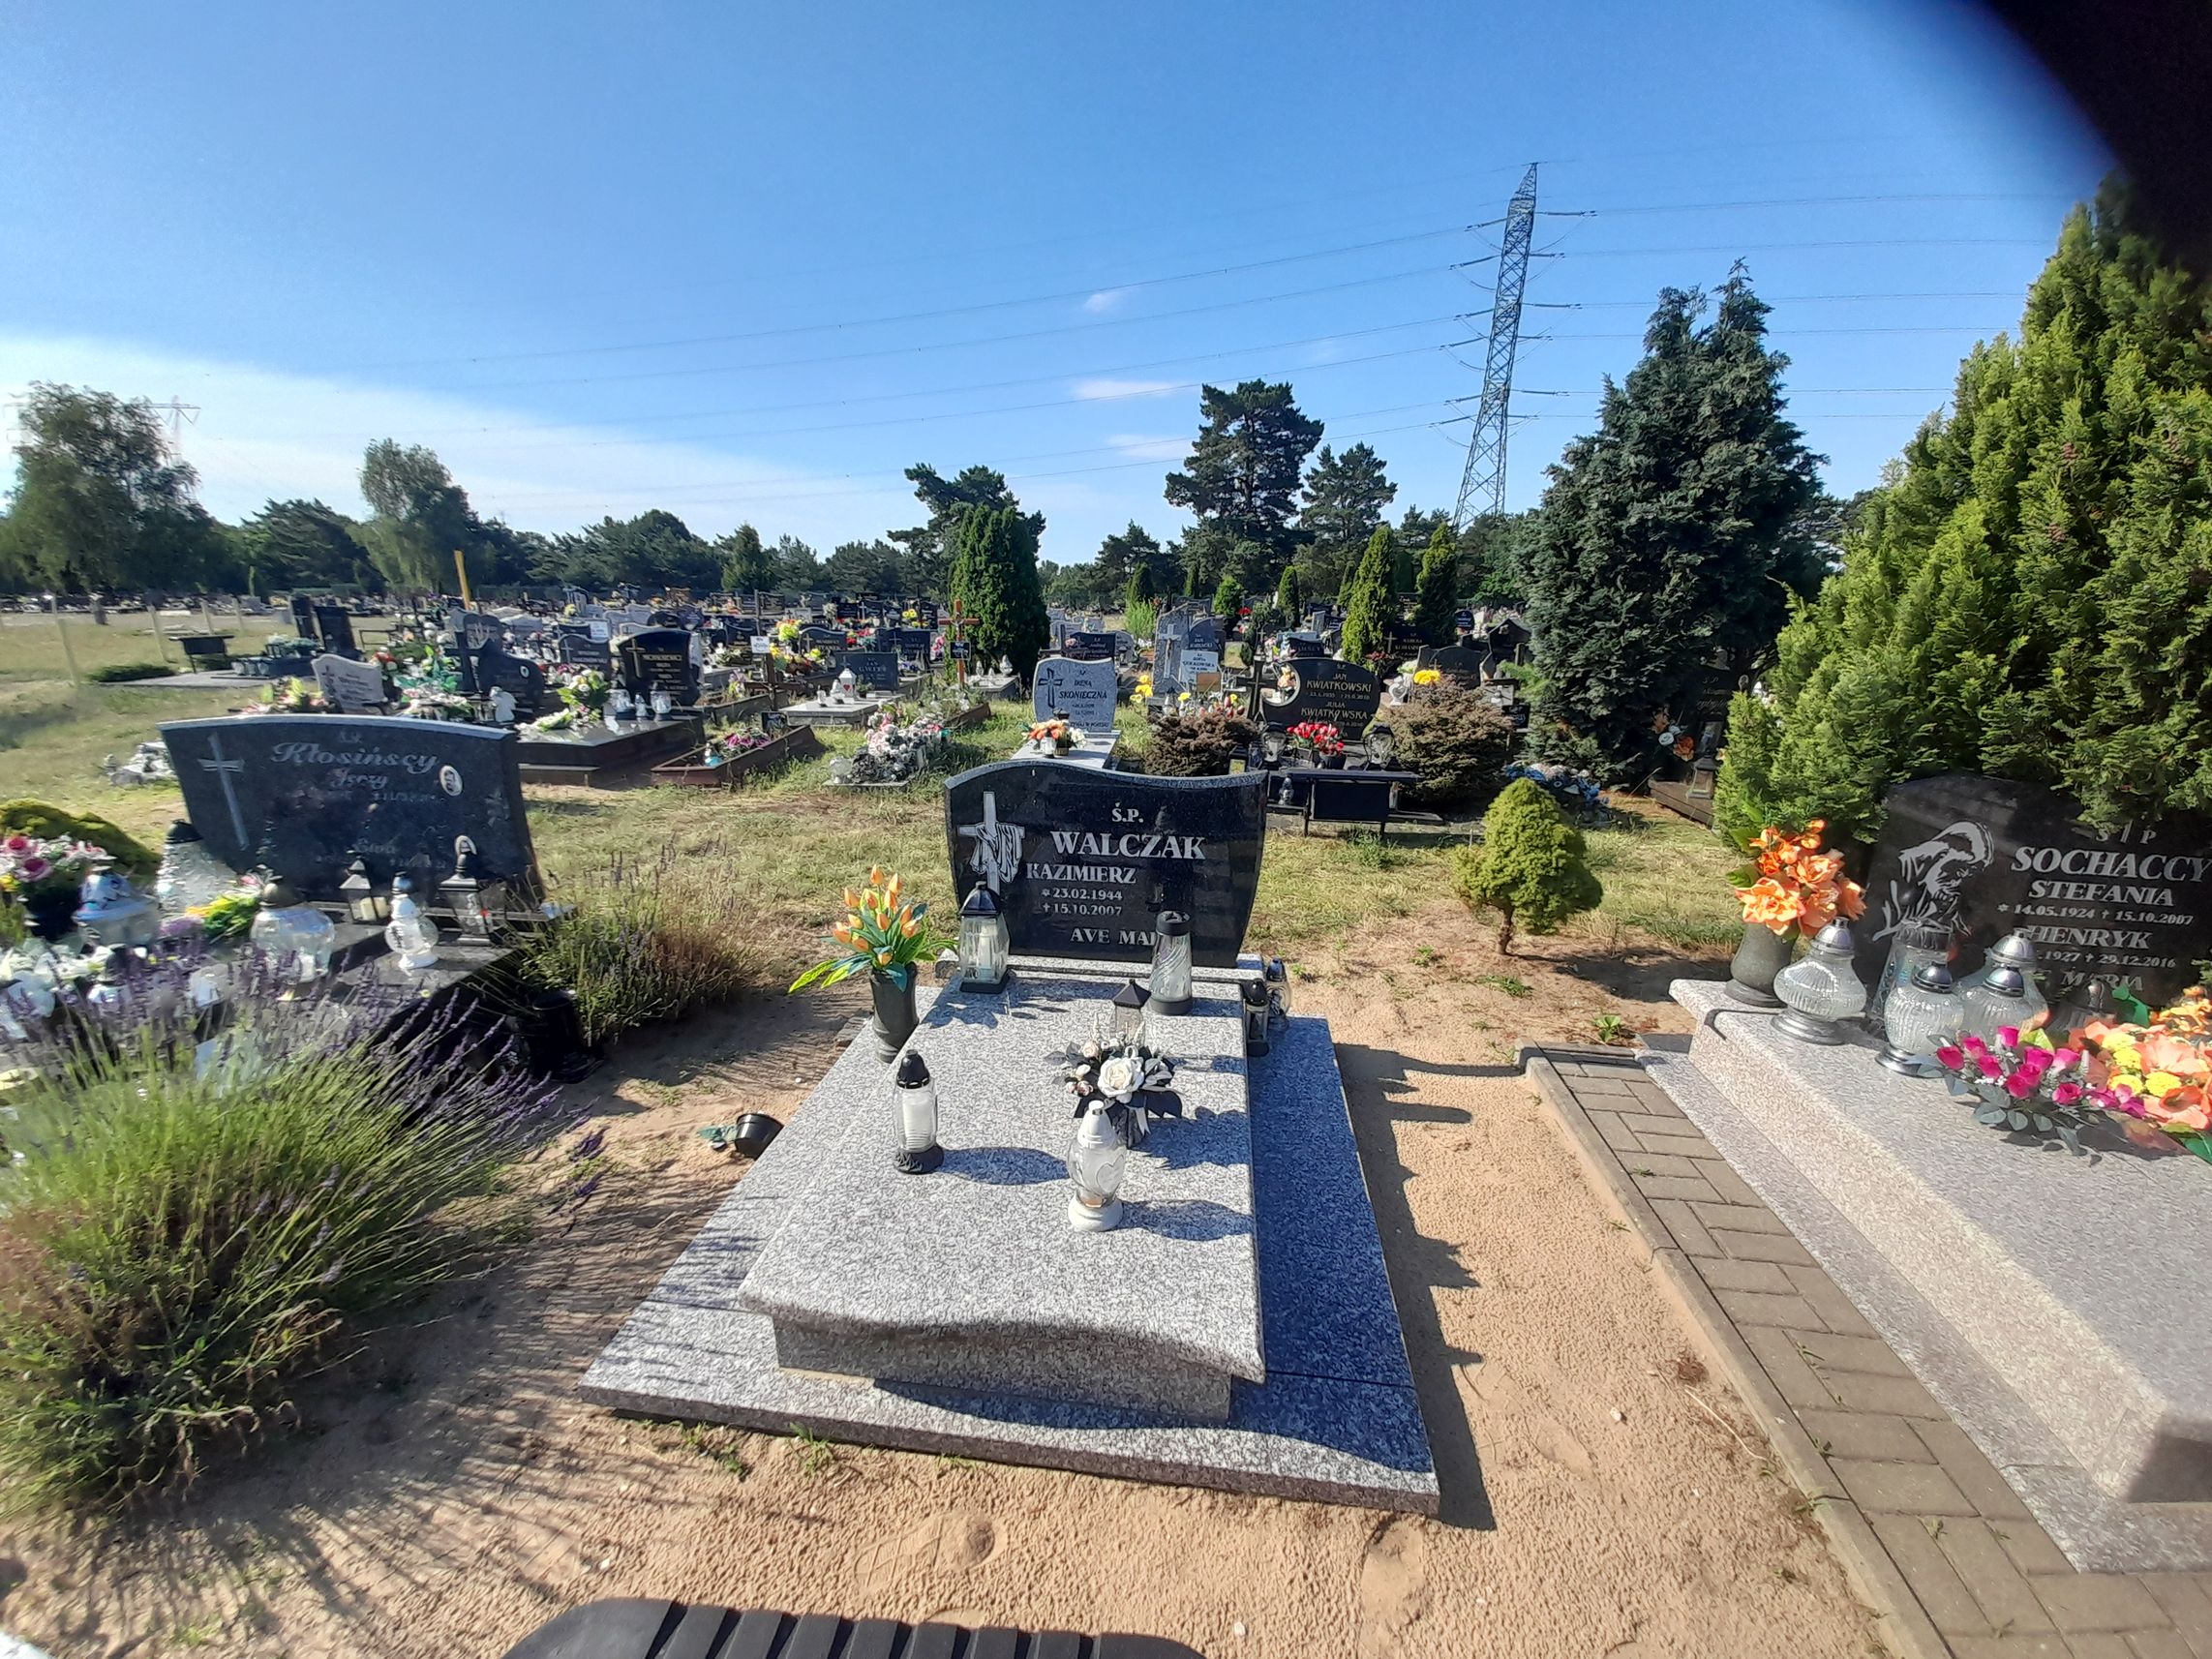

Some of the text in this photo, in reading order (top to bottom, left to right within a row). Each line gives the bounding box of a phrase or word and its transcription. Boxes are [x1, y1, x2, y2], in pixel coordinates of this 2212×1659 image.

[1059, 690, 1107, 699] SKONIECZNA
[1306, 679, 1372, 692] KWIATKOWSKI
[1300, 707, 1368, 720] KWIATKOWSKA
[1049, 830, 1206, 860] WALCZAK
[1026, 861, 1136, 884] KAZIMIERZ
[2011, 846, 2212, 883] SOCHACCY
[1052, 888, 1123, 901] 23.02.1944
[2028, 879, 2174, 907] STEFANIA
[1053, 903, 1122, 917] 15.10.2007
[2014, 904, 2194, 925] 14.05.1924 15.10.2007
[1070, 927, 1110, 944] AVE
[2027, 924, 2153, 950] HENRYK
[2098, 953, 2177, 968] 29.12.2016
[2061, 969, 2144, 991] MRIA
